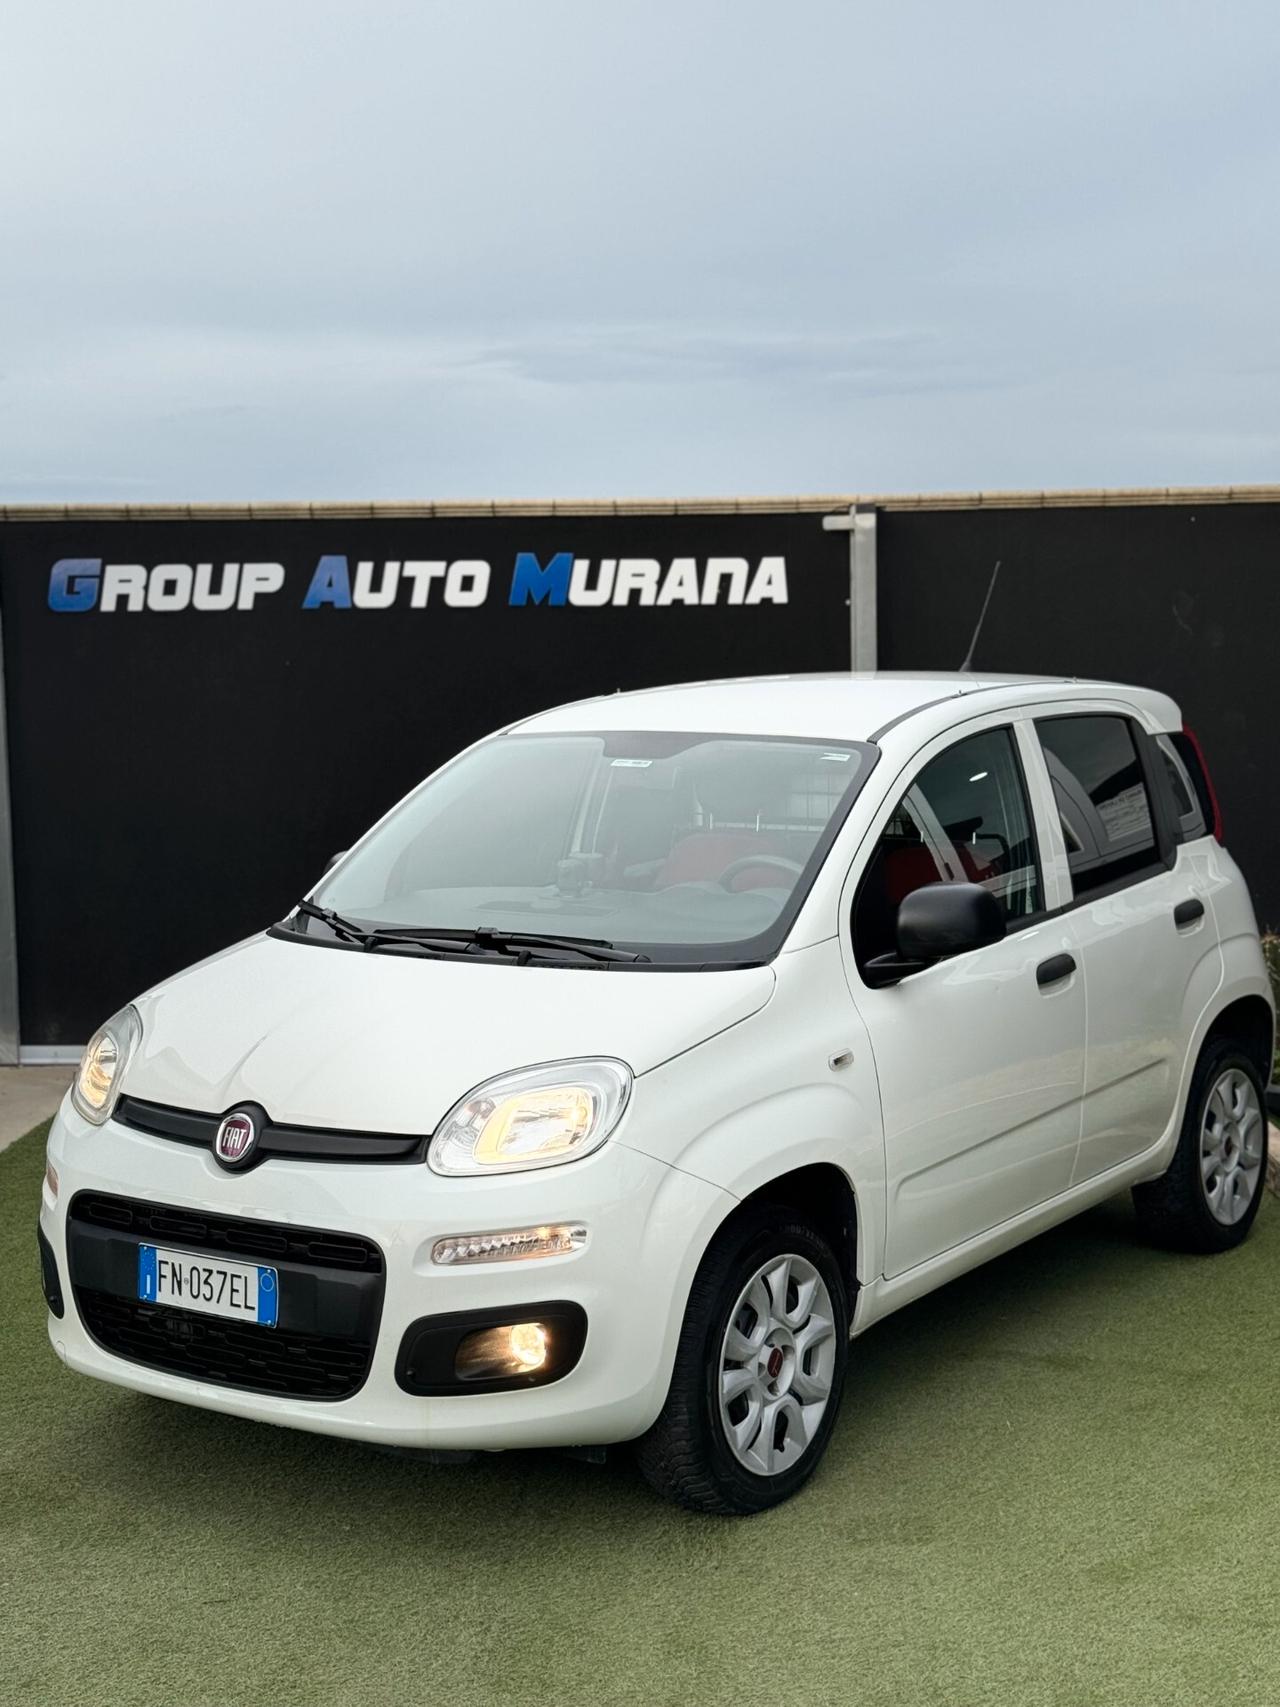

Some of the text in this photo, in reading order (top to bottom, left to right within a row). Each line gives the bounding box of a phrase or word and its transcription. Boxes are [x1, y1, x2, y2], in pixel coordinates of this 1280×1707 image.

[48, 552, 788, 612] GROUP AUTO MURANA
[222, 1126, 248, 1150] FIAT
